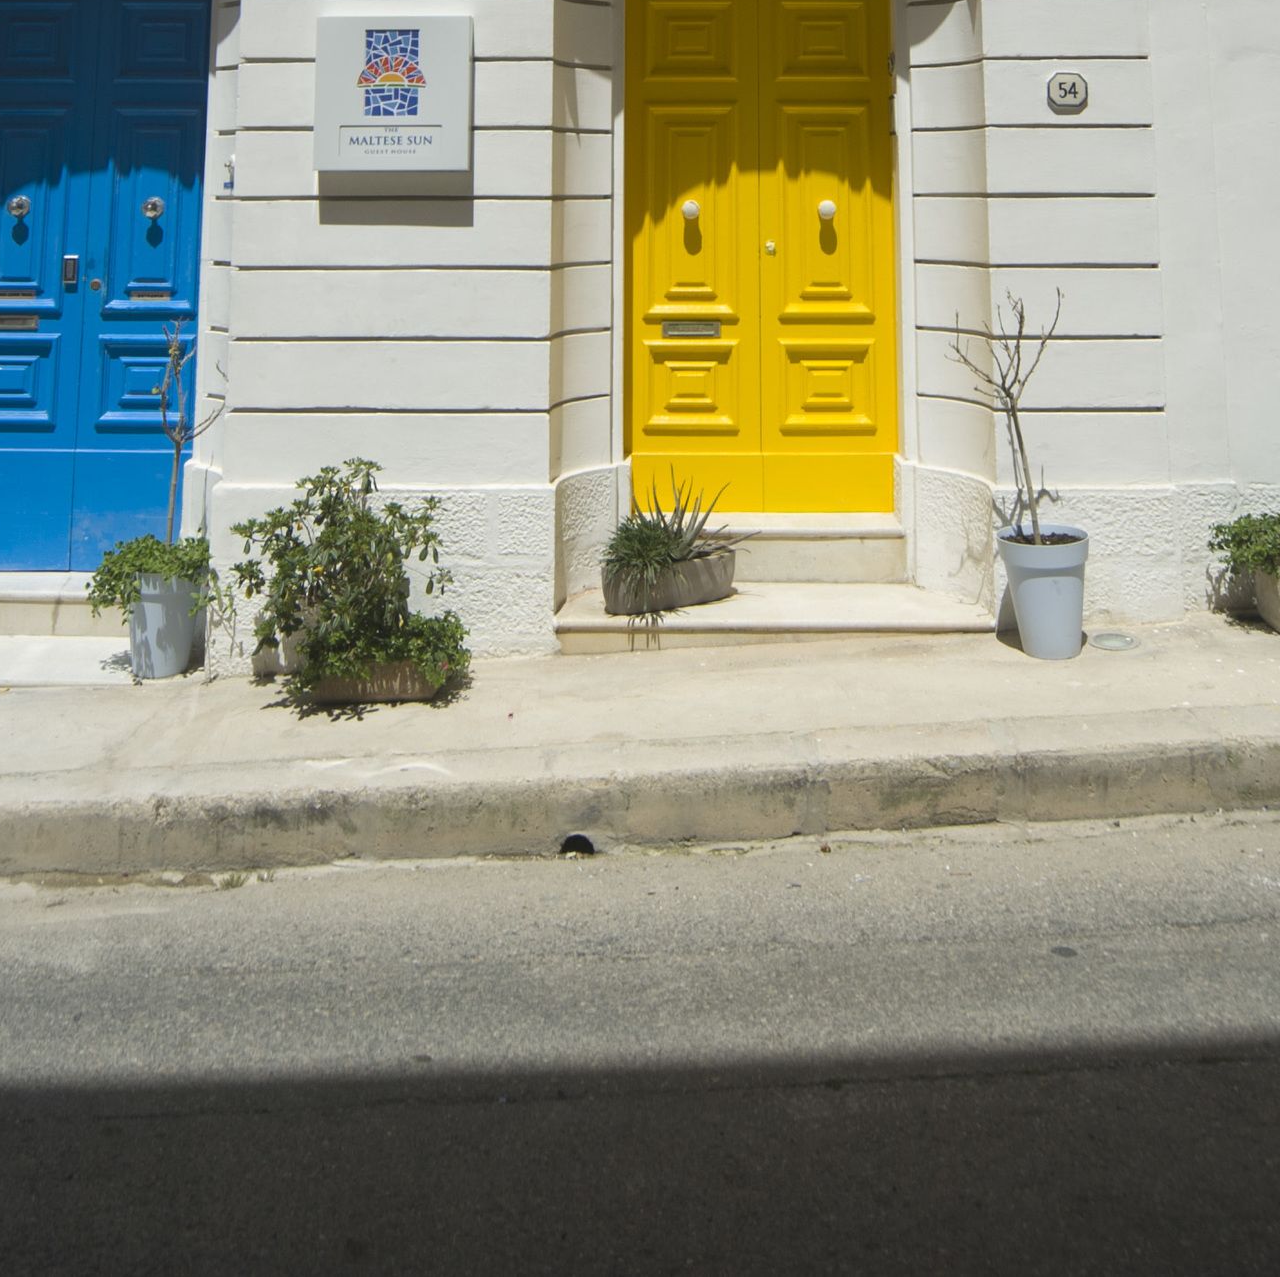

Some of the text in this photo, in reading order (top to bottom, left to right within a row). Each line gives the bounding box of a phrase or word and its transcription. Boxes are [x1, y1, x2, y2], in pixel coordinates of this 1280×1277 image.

[1058, 82, 1078, 99] 54
[349, 135, 433, 146] MALTESE SUN
